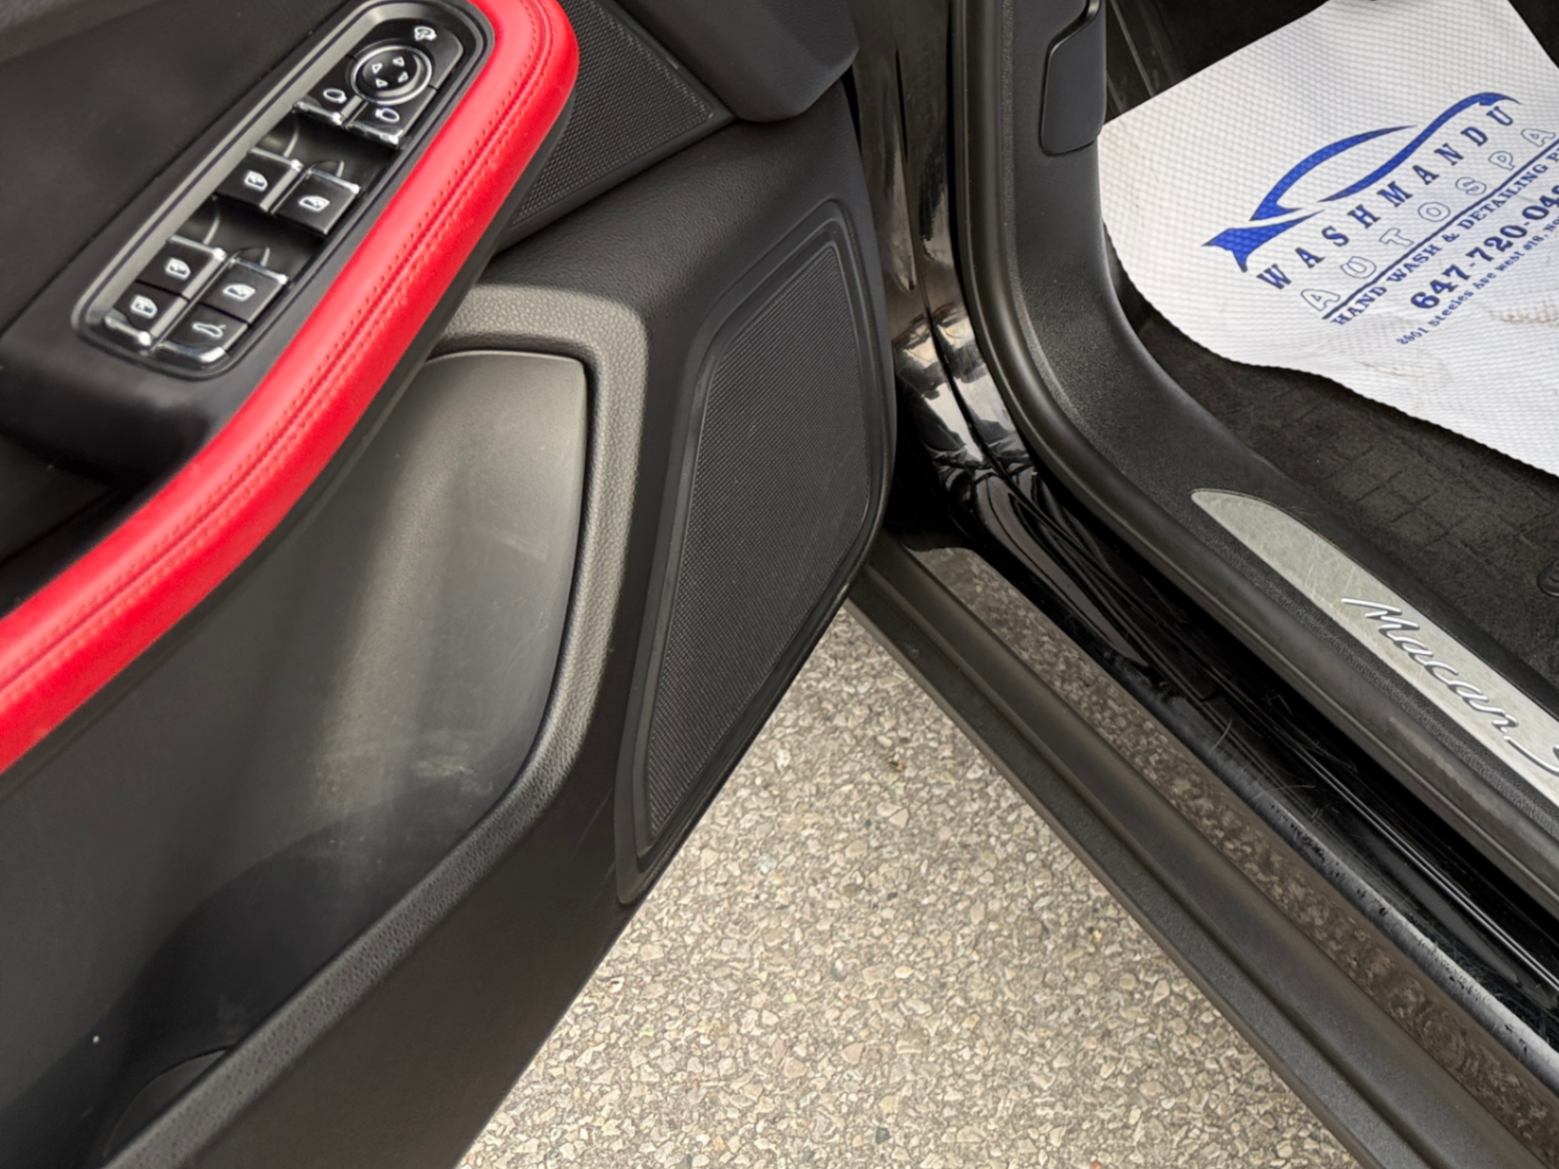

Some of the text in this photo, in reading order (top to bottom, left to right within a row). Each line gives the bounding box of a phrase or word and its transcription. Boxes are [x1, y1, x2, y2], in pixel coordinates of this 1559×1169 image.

[1256, 106, 1514, 290] WASHMANDU
[1330, 285, 1388, 326] HAND
[1386, 244, 1442, 283] WASH
[1441, 232, 1460, 243] &
[1457, 163, 1549, 230] DETAILING
[1428, 290, 1474, 326] Steeles
[1341, 598, 1519, 734] Macan
